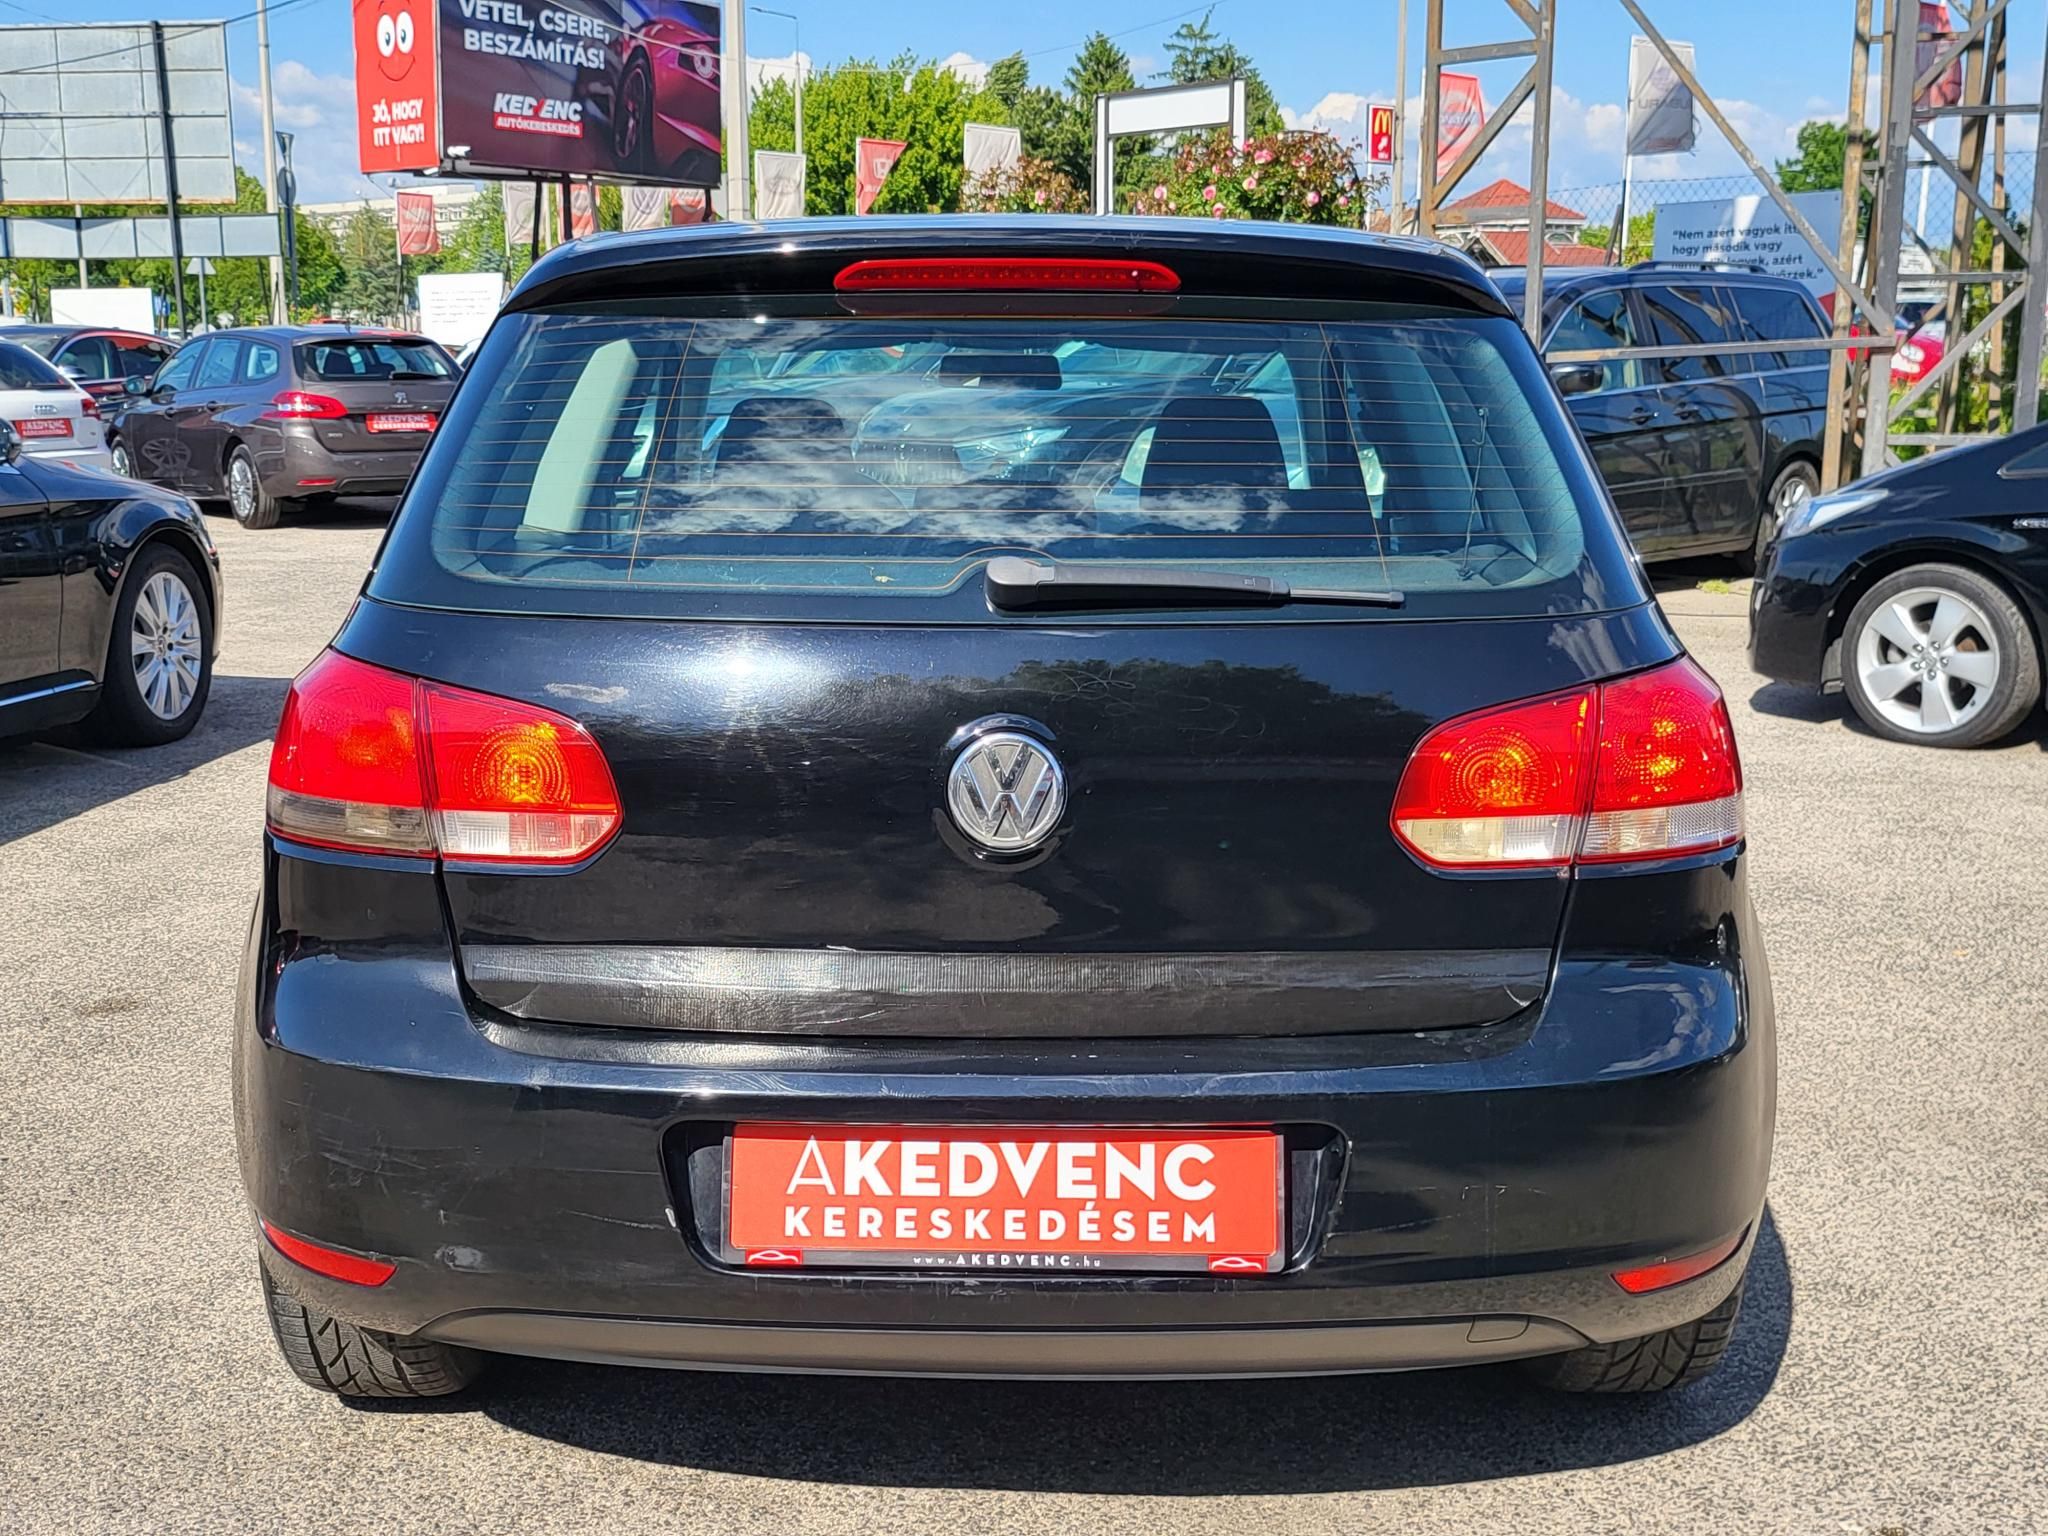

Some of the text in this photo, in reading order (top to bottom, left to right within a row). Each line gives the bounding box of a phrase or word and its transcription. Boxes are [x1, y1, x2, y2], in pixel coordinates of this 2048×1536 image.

[539, 9, 610, 44] CSERE,
[463, 28, 606, 70] BESZÁMÍTÁS!
[372, 97, 424, 126] JÓ, HOGY
[373, 122, 425, 147] ITT VAGY!
[1739, 223, 1781, 239] vagyok
[1672, 240, 1783, 257] hogy második vagy
[1772, 254, 1803, 265] azért
[785, 1134, 1216, 1200] AKEDVENC
[784, 1201, 1216, 1244] KERESKEDÉSEM
